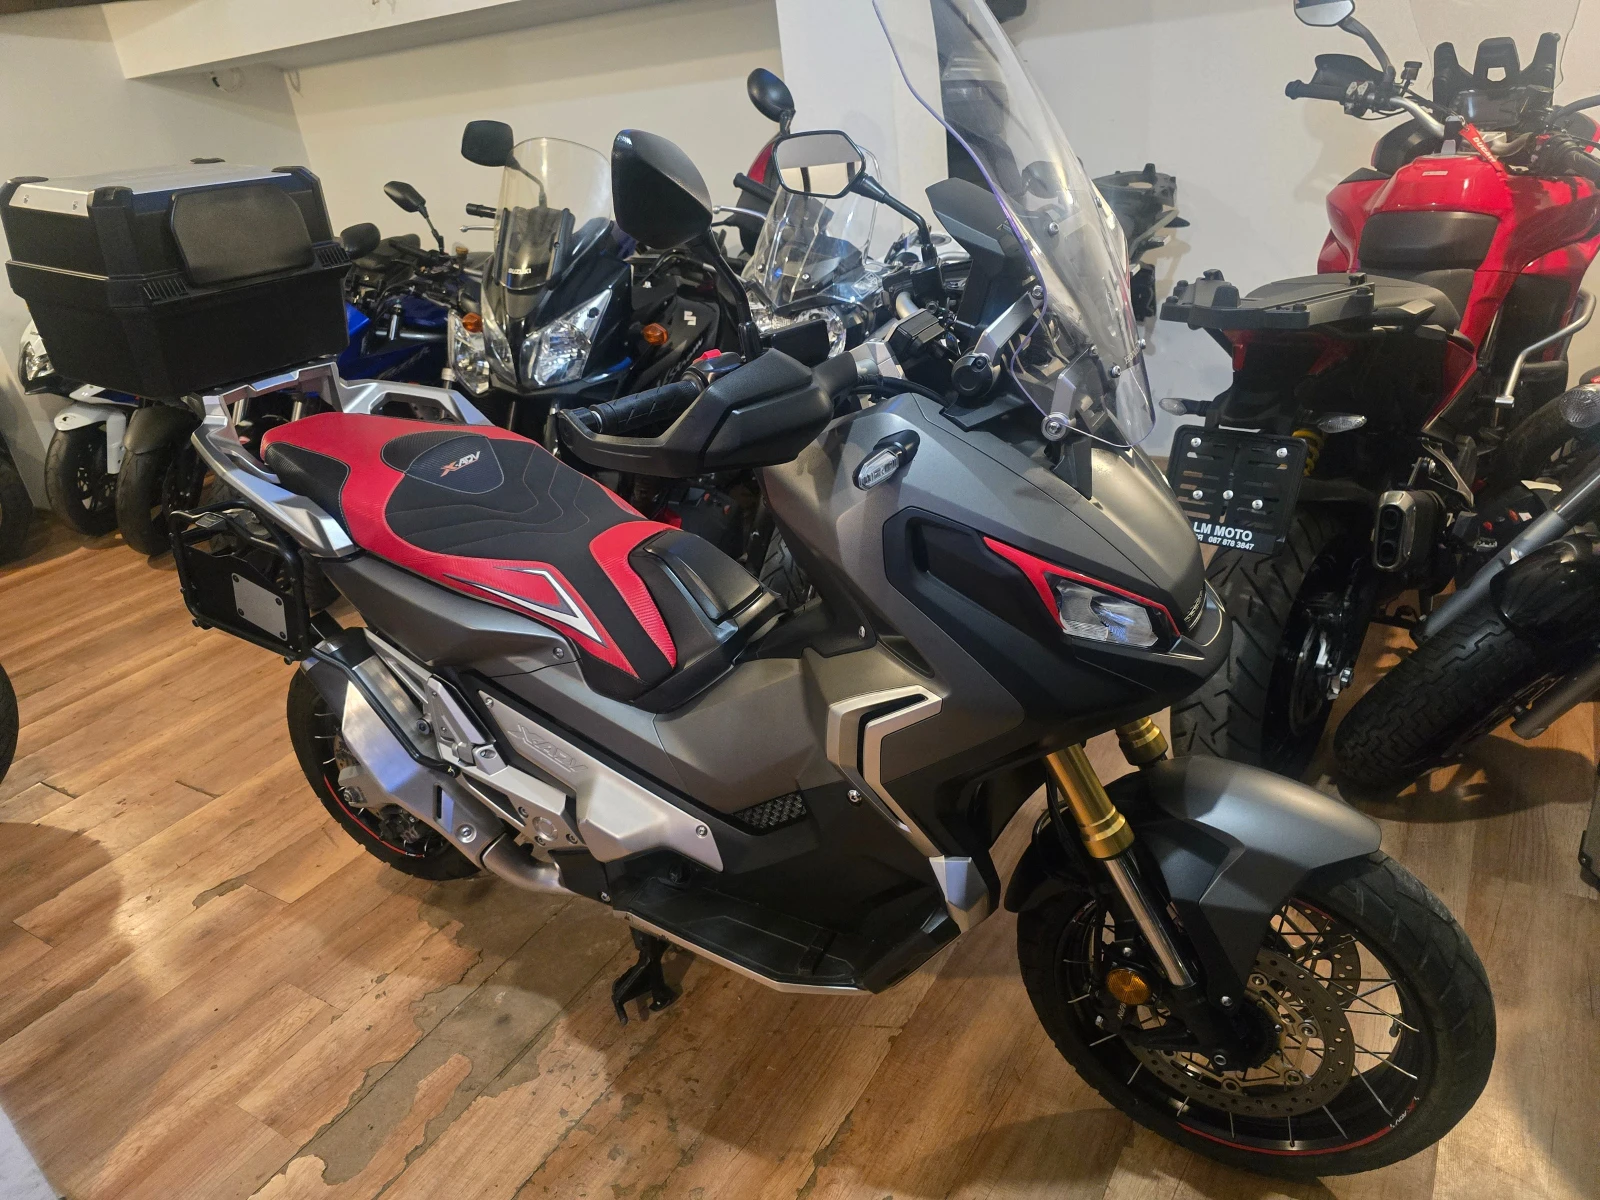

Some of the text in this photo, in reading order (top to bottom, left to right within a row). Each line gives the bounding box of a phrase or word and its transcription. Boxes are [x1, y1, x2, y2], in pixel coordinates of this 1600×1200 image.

[1472, 137, 1497, 162] DUCATI
[440, 450, 480, 477] X-ADV
[1213, 525, 1253, 541] MOTO
